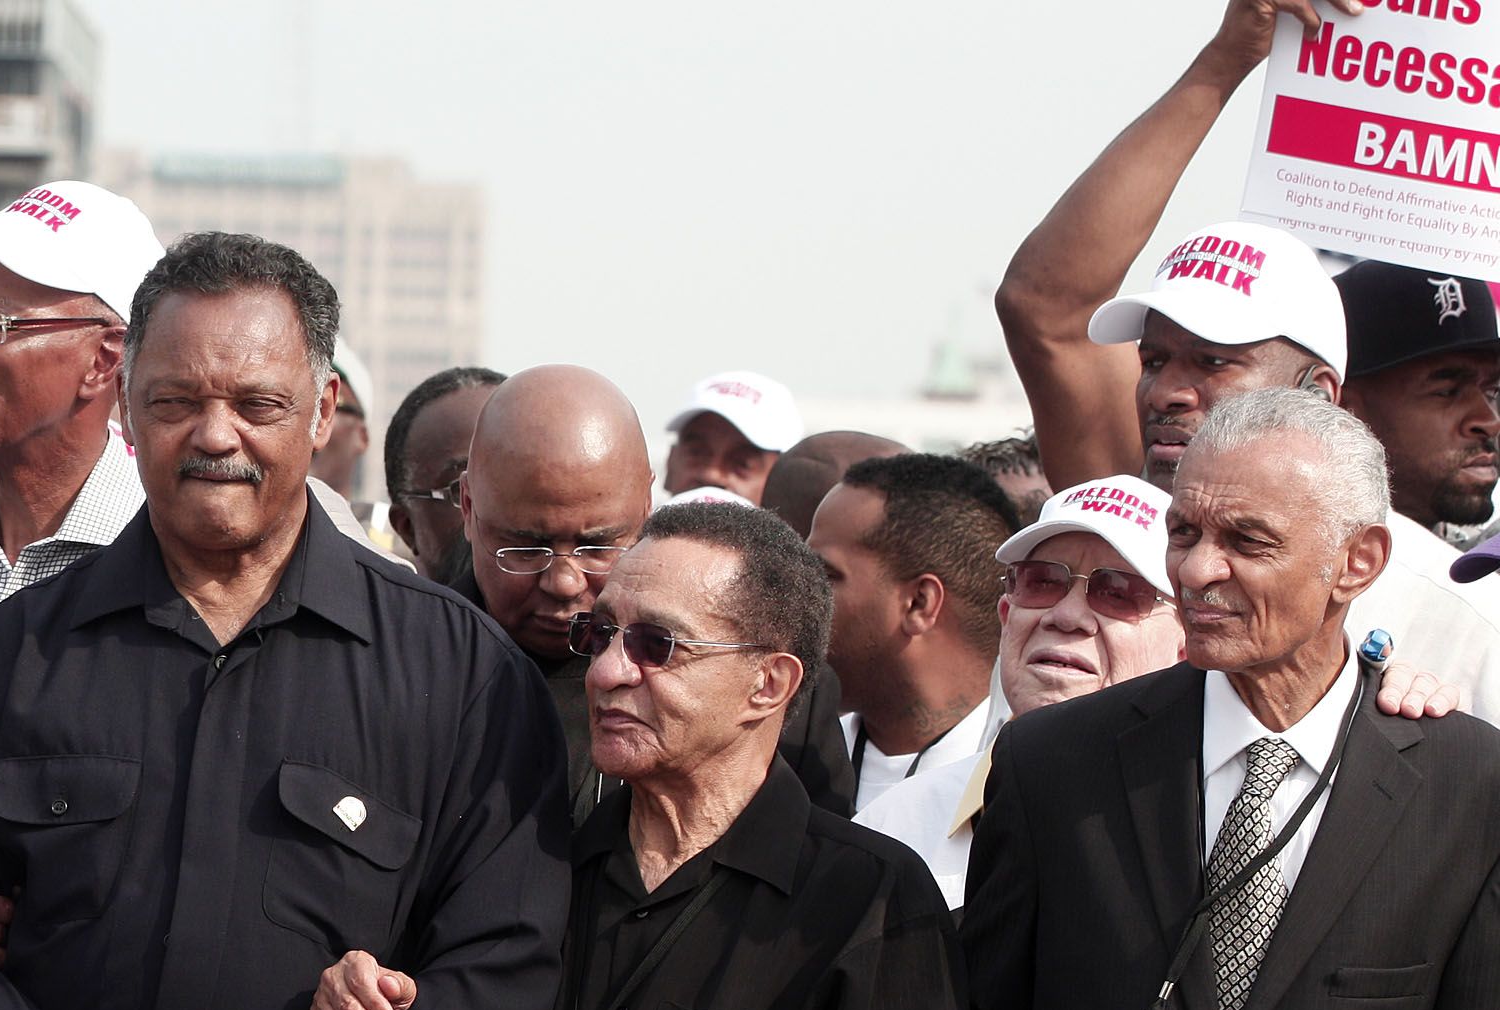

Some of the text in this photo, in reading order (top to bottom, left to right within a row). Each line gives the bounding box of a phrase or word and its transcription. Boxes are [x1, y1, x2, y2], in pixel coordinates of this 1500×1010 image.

[1354, 121, 1500, 188] BAMN
[1277, 169, 1330, 189] Coalition
[1333, 181, 1345, 192] to
[1349, 182, 1393, 201] Defend
[1396, 192, 1466, 214] Affirmative
[5, 202, 66, 232] WALK
[1286, 190, 1500, 242] Rights and Fight for Equality By An
[1167, 259, 1256, 296] WALK
[1064, 487, 1158, 520] FREEDOM
[1081, 501, 1152, 531] WALK
